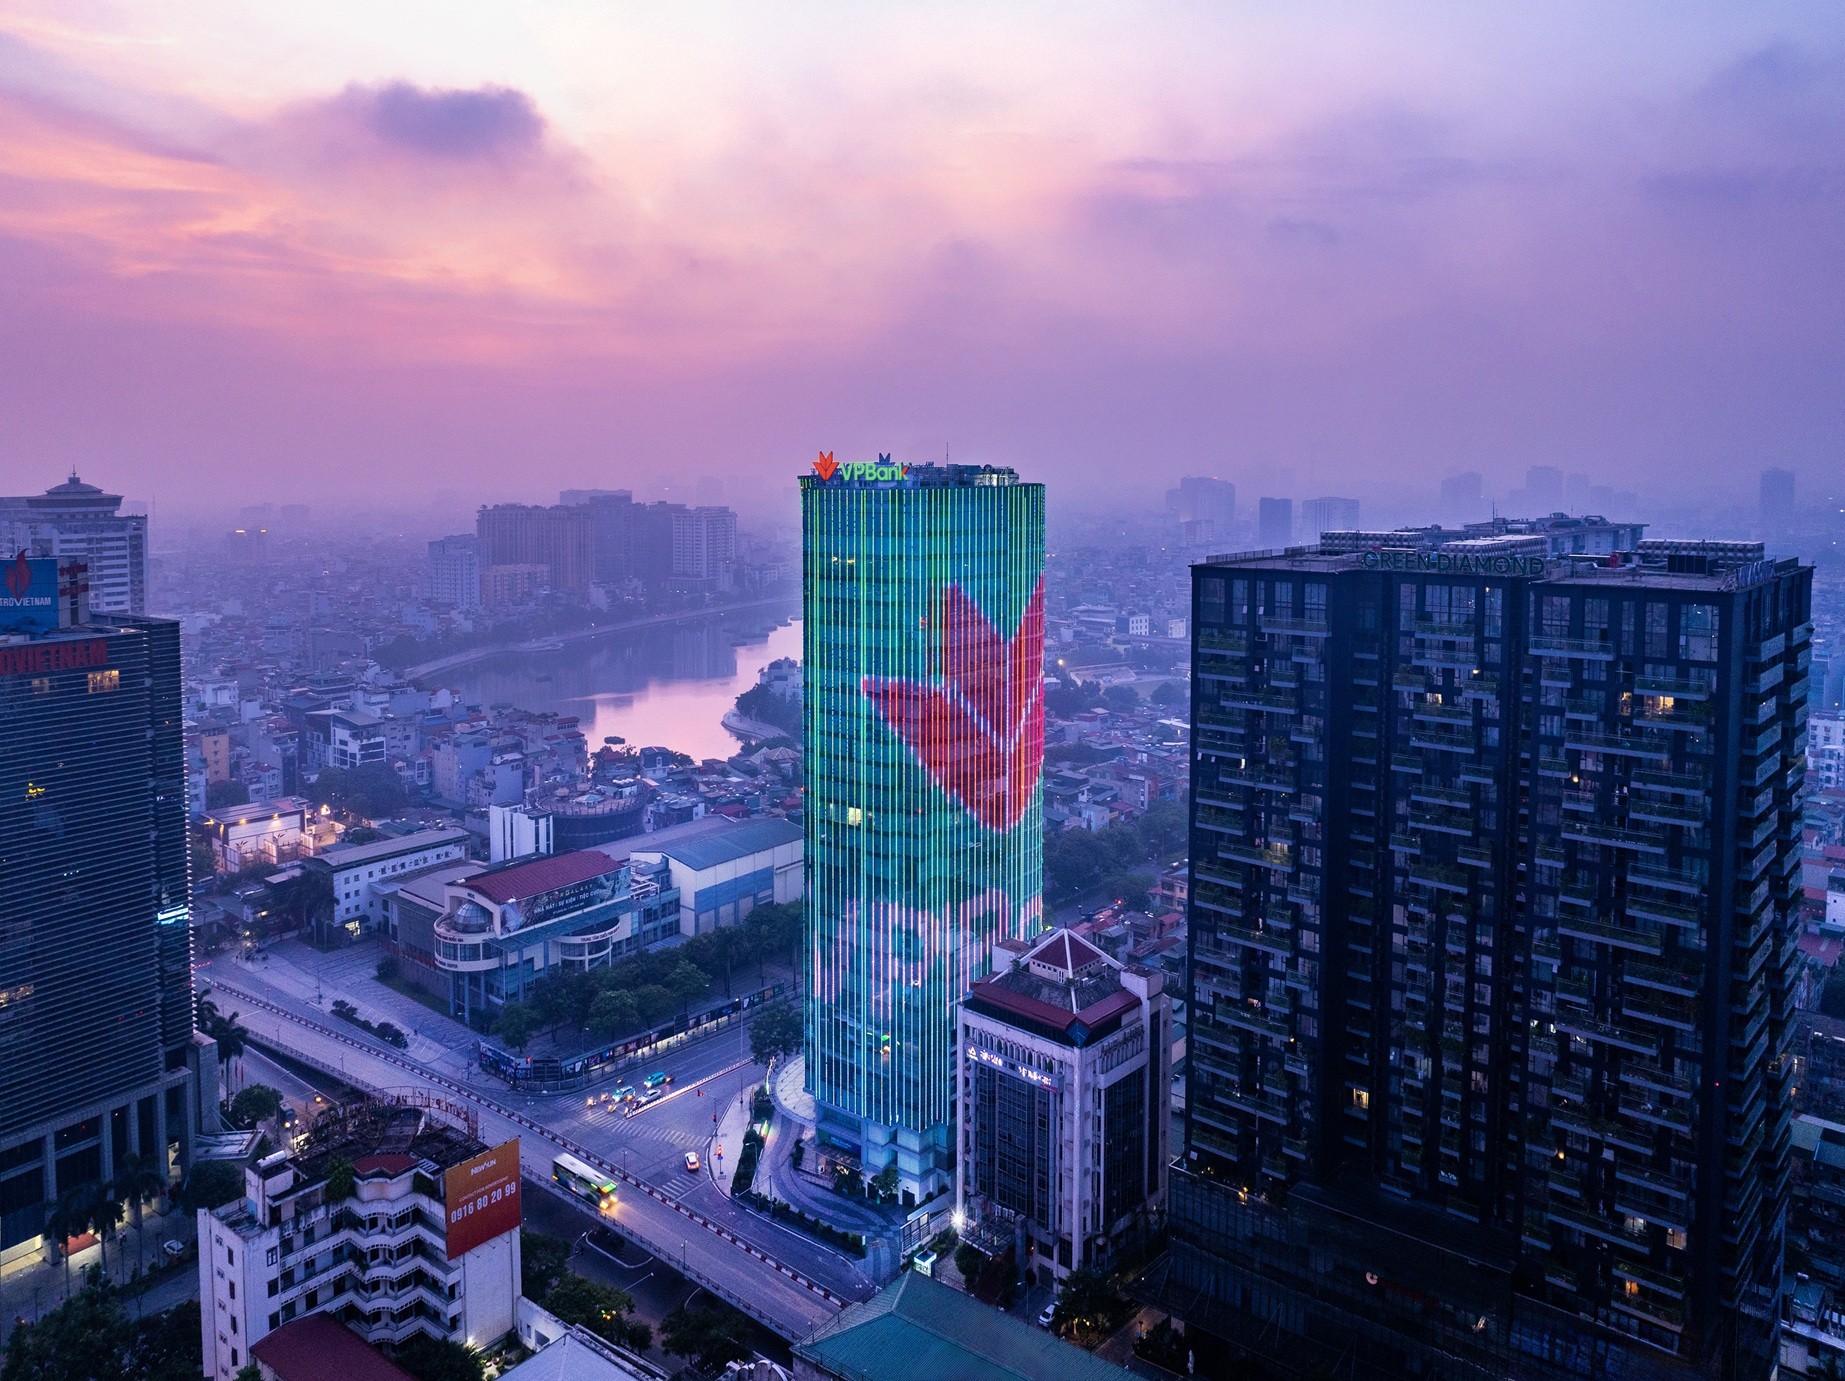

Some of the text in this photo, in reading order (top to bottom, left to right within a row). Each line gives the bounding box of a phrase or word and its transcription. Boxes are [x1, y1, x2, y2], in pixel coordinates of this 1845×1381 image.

[841, 462, 909, 482] VPBank
[1362, 551, 1545, 575] GREEN DIAMOND
[451, 1181, 516, 1223] 0916 80 20 99
